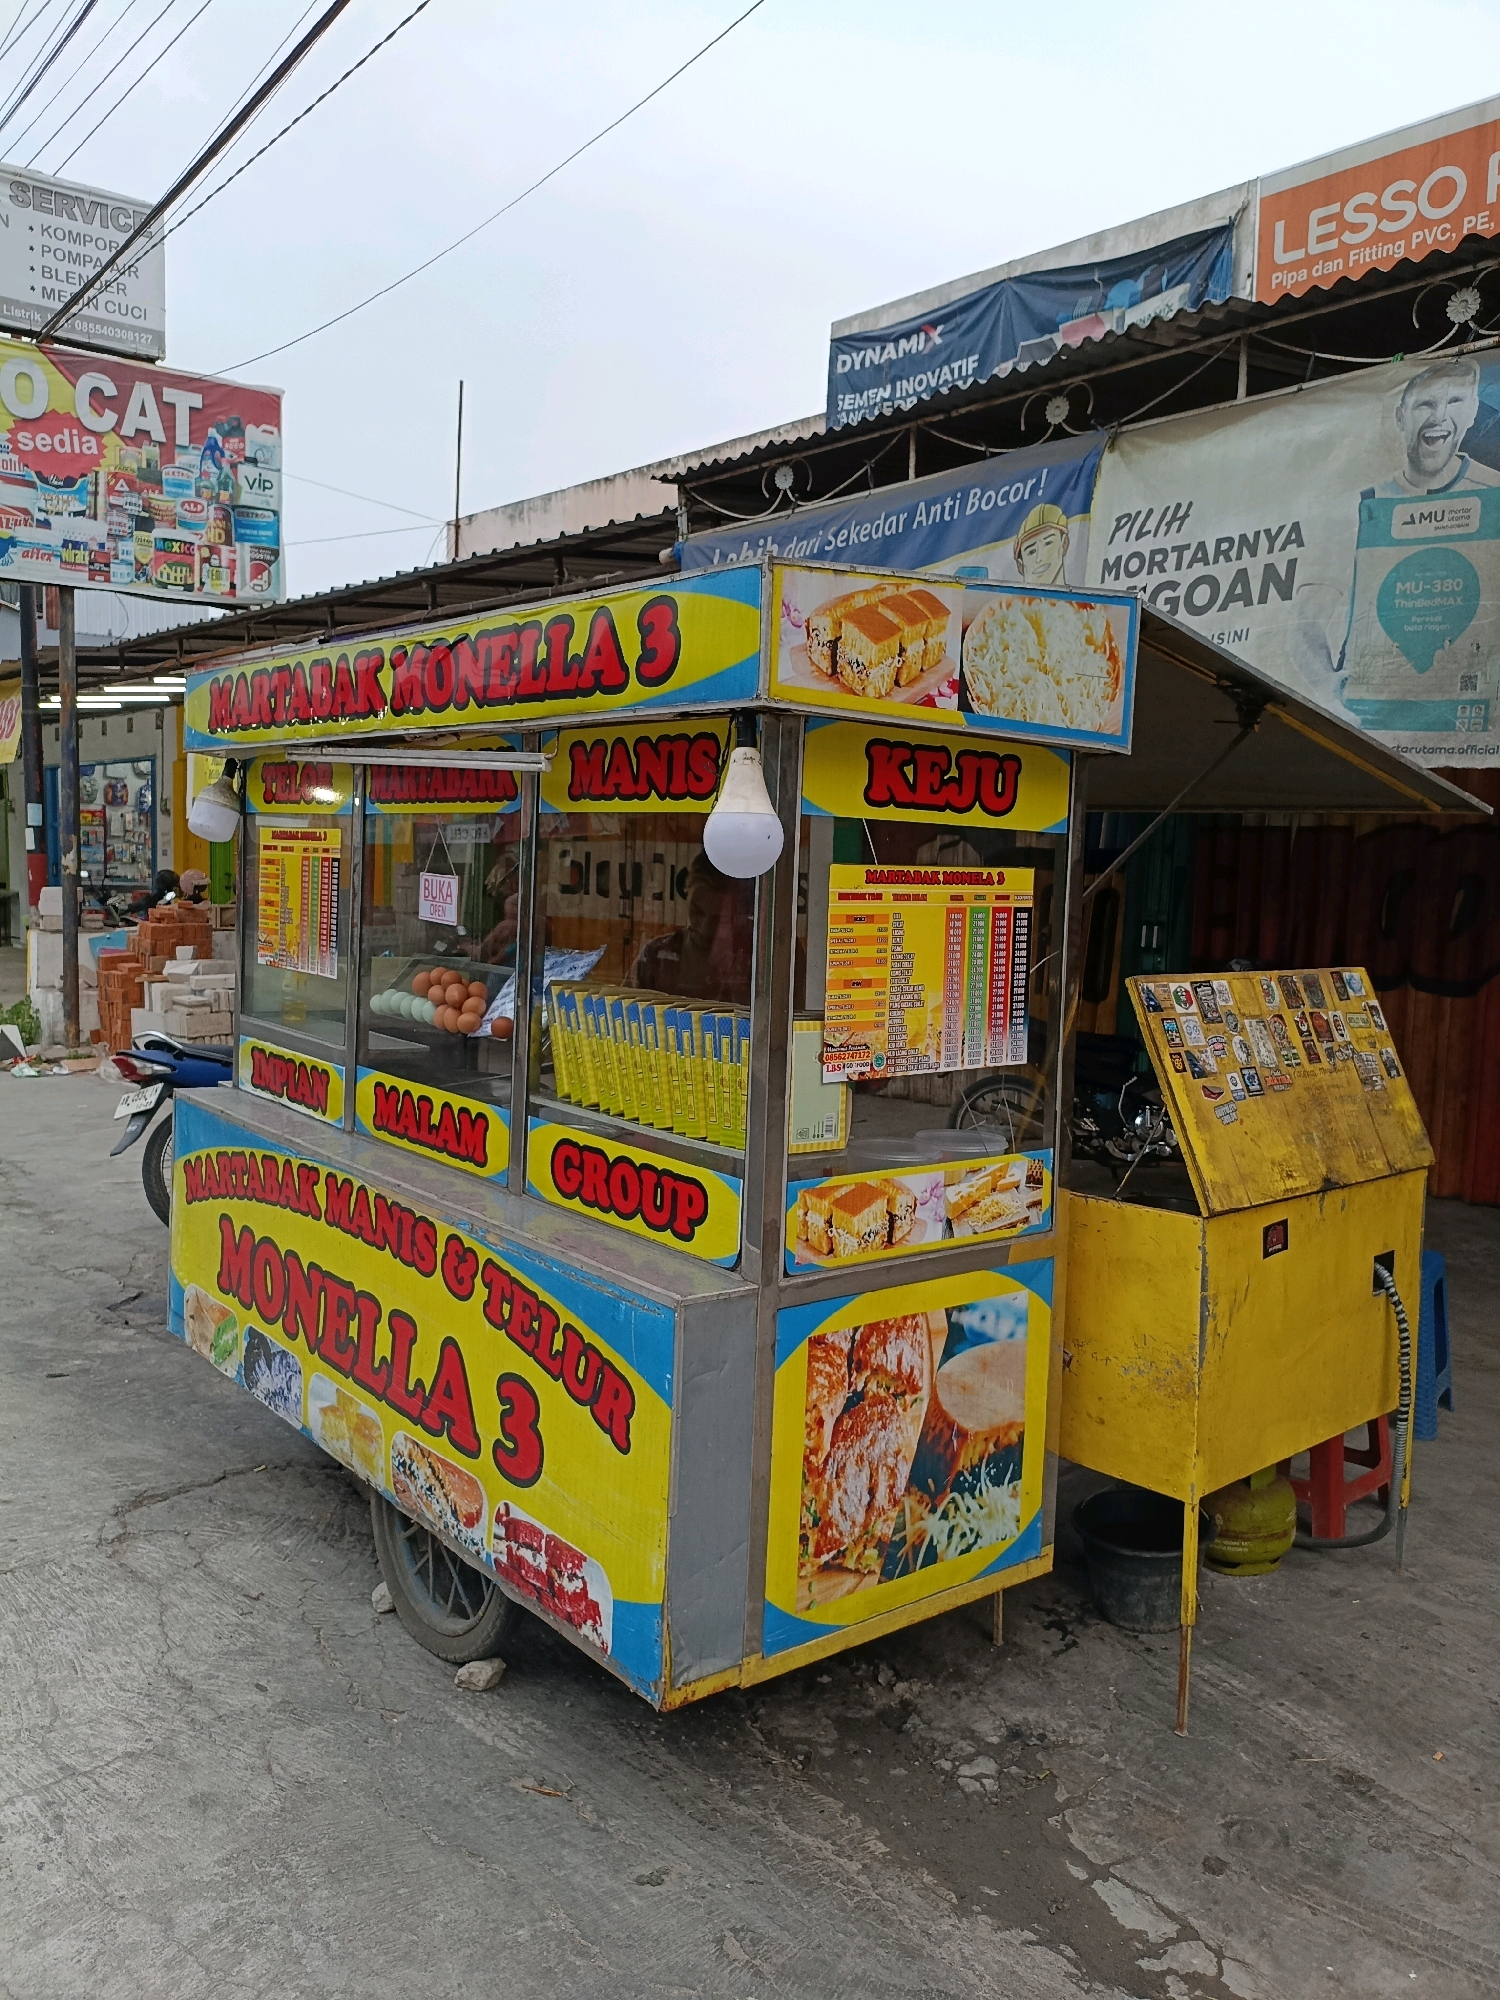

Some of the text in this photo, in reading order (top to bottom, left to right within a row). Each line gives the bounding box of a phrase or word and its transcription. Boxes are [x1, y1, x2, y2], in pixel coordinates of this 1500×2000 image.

[1273, 165, 1467, 265] LESSO
[41, 244, 139, 279] POMPA AIR
[1271, 210, 1494, 289] Pipa dan Fitting PVC, PE,
[104, 300, 147, 320] CUCI
[836, 324, 944, 374] DYNAMIX
[895, 354, 980, 398] INOVATIF
[17, 428, 98, 455] sedia
[74, 371, 203, 447] CAT
[783, 530, 823, 558] dari
[825, 503, 907, 551] Sekedar
[911, 496, 960, 529] Anti
[965, 468, 1049, 517] Bocor!
[1108, 501, 1194, 546] PILIH
[1100, 521, 1305, 584] MORTARNYA
[1126, 558, 1298, 617] GOAN
[1395, 578, 1464, 594] MU-380
[207, 594, 682, 734] MARTABAK MONELLA 3
[567, 732, 721, 802] MANIS
[863, 738, 1021, 817] KEJU
[423, 878, 453, 902] BUKA
[865, 869, 941, 885] MARTABAK
[429, 903, 447, 918] OPEN
[250, 1045, 330, 1116] IMPIAN
[373, 1081, 490, 1168] MALAM
[550, 1137, 709, 1243] GROUP
[183, 1150, 636, 1455] MARTABAK MANIS & TELUR
[216, 1212, 545, 1489] MONELLA 3
